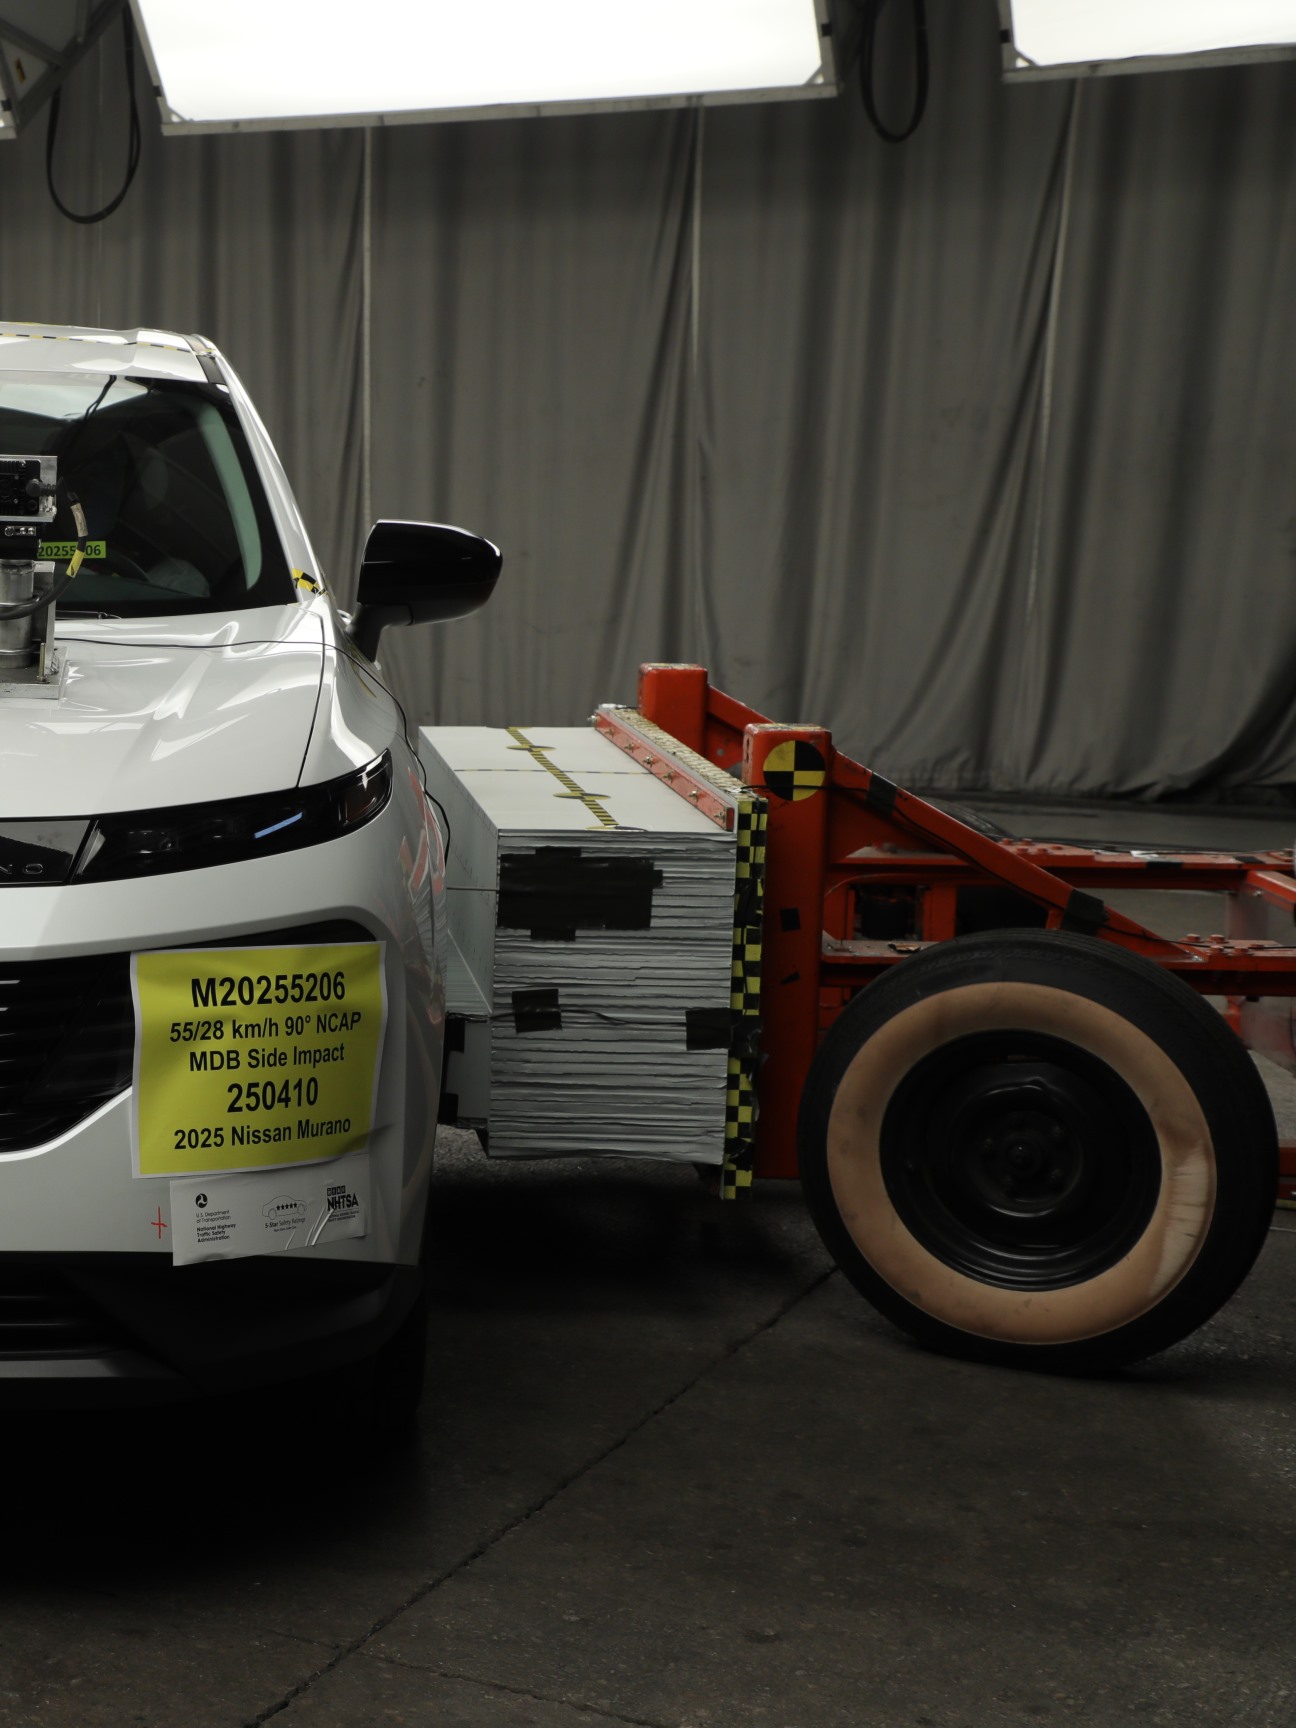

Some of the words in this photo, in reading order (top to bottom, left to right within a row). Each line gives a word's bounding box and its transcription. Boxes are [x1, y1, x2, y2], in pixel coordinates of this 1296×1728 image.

[38, 545, 101, 556] 2025506
[191, 971, 346, 1008] M20255206
[170, 1020, 224, 1042] 55/28
[232, 1018, 279, 1040] km/h
[316, 1012, 362, 1034] NCAP
[189, 1050, 240, 1072] MDB
[247, 1046, 288, 1069] Side
[293, 1042, 345, 1068] Impact
[227, 1076, 319, 1113] 250410
[174, 1127, 225, 1150] 2025
[231, 1124, 292, 1146] Nissan
[297, 1118, 351, 1140] Murano
[327, 1192, 359, 1212] NHTSA
